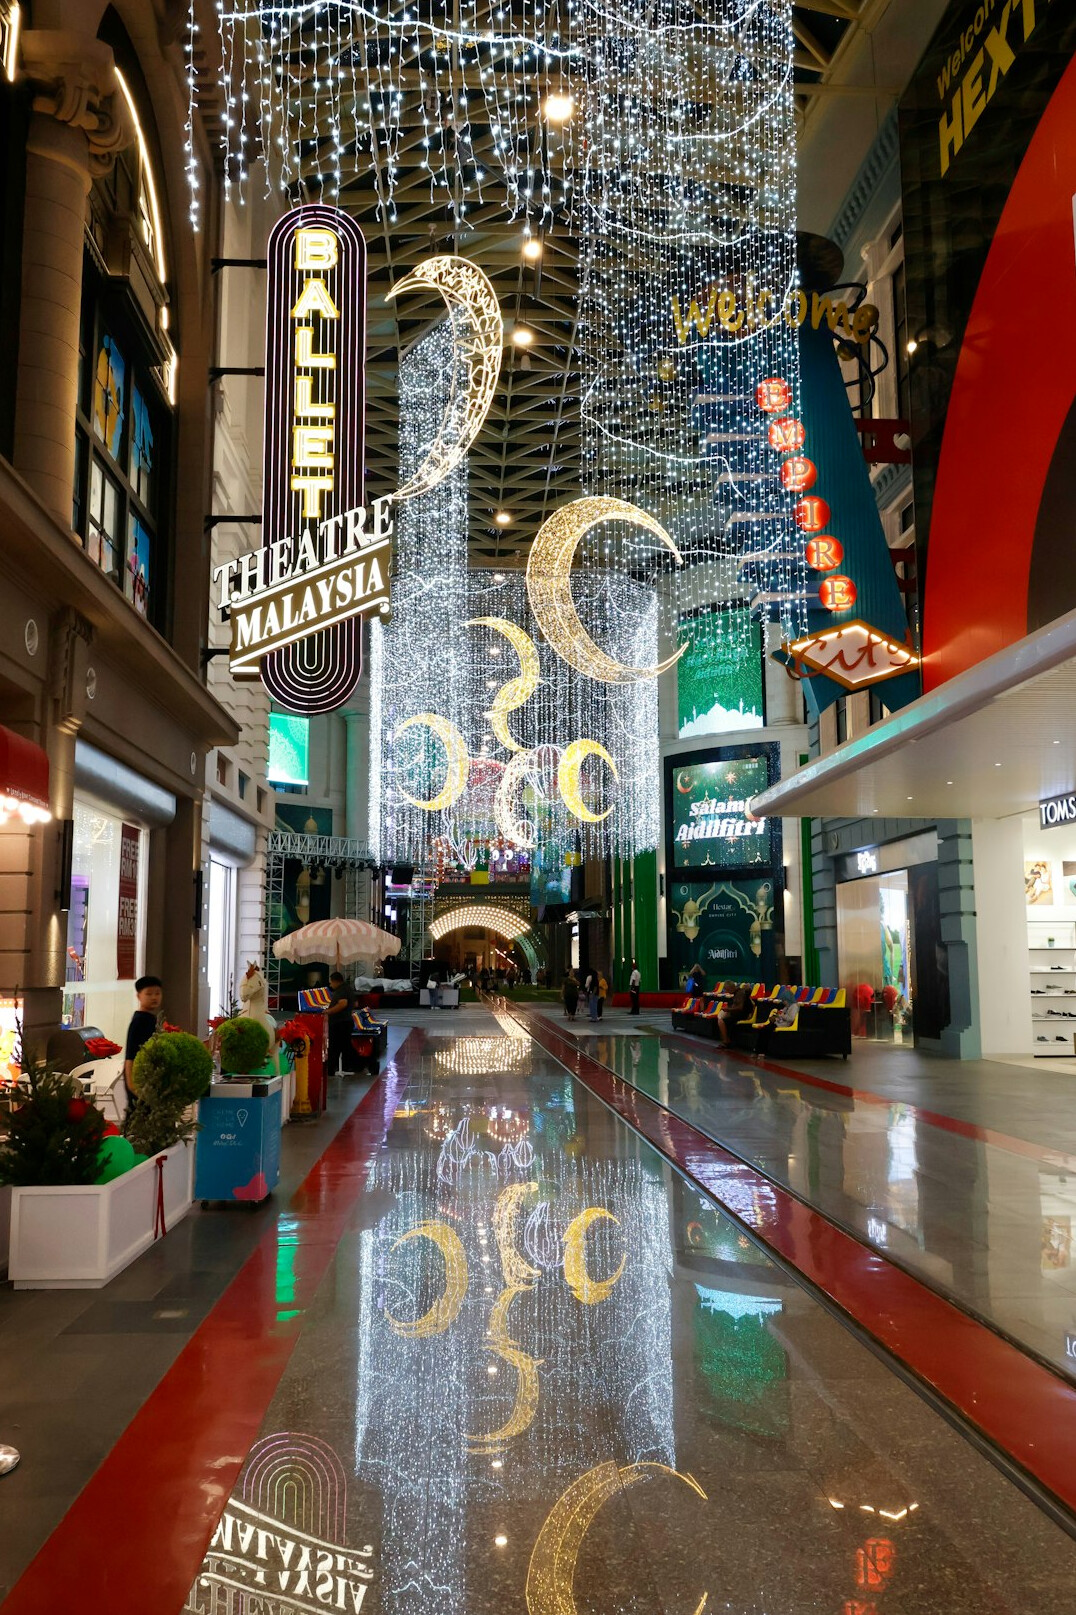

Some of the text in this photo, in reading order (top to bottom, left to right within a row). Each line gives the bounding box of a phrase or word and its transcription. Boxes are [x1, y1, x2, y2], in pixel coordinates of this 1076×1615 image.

[671, 269, 873, 345] Welcome
[290, 228, 340, 519] BALLET
[762, 381, 853, 608] EMPIRE
[213, 492, 395, 611] THEATRE
[235, 556, 387, 652] MALAYSIA
[689, 797, 745, 817] Salam
[1039, 796, 1076, 825] TOMS
